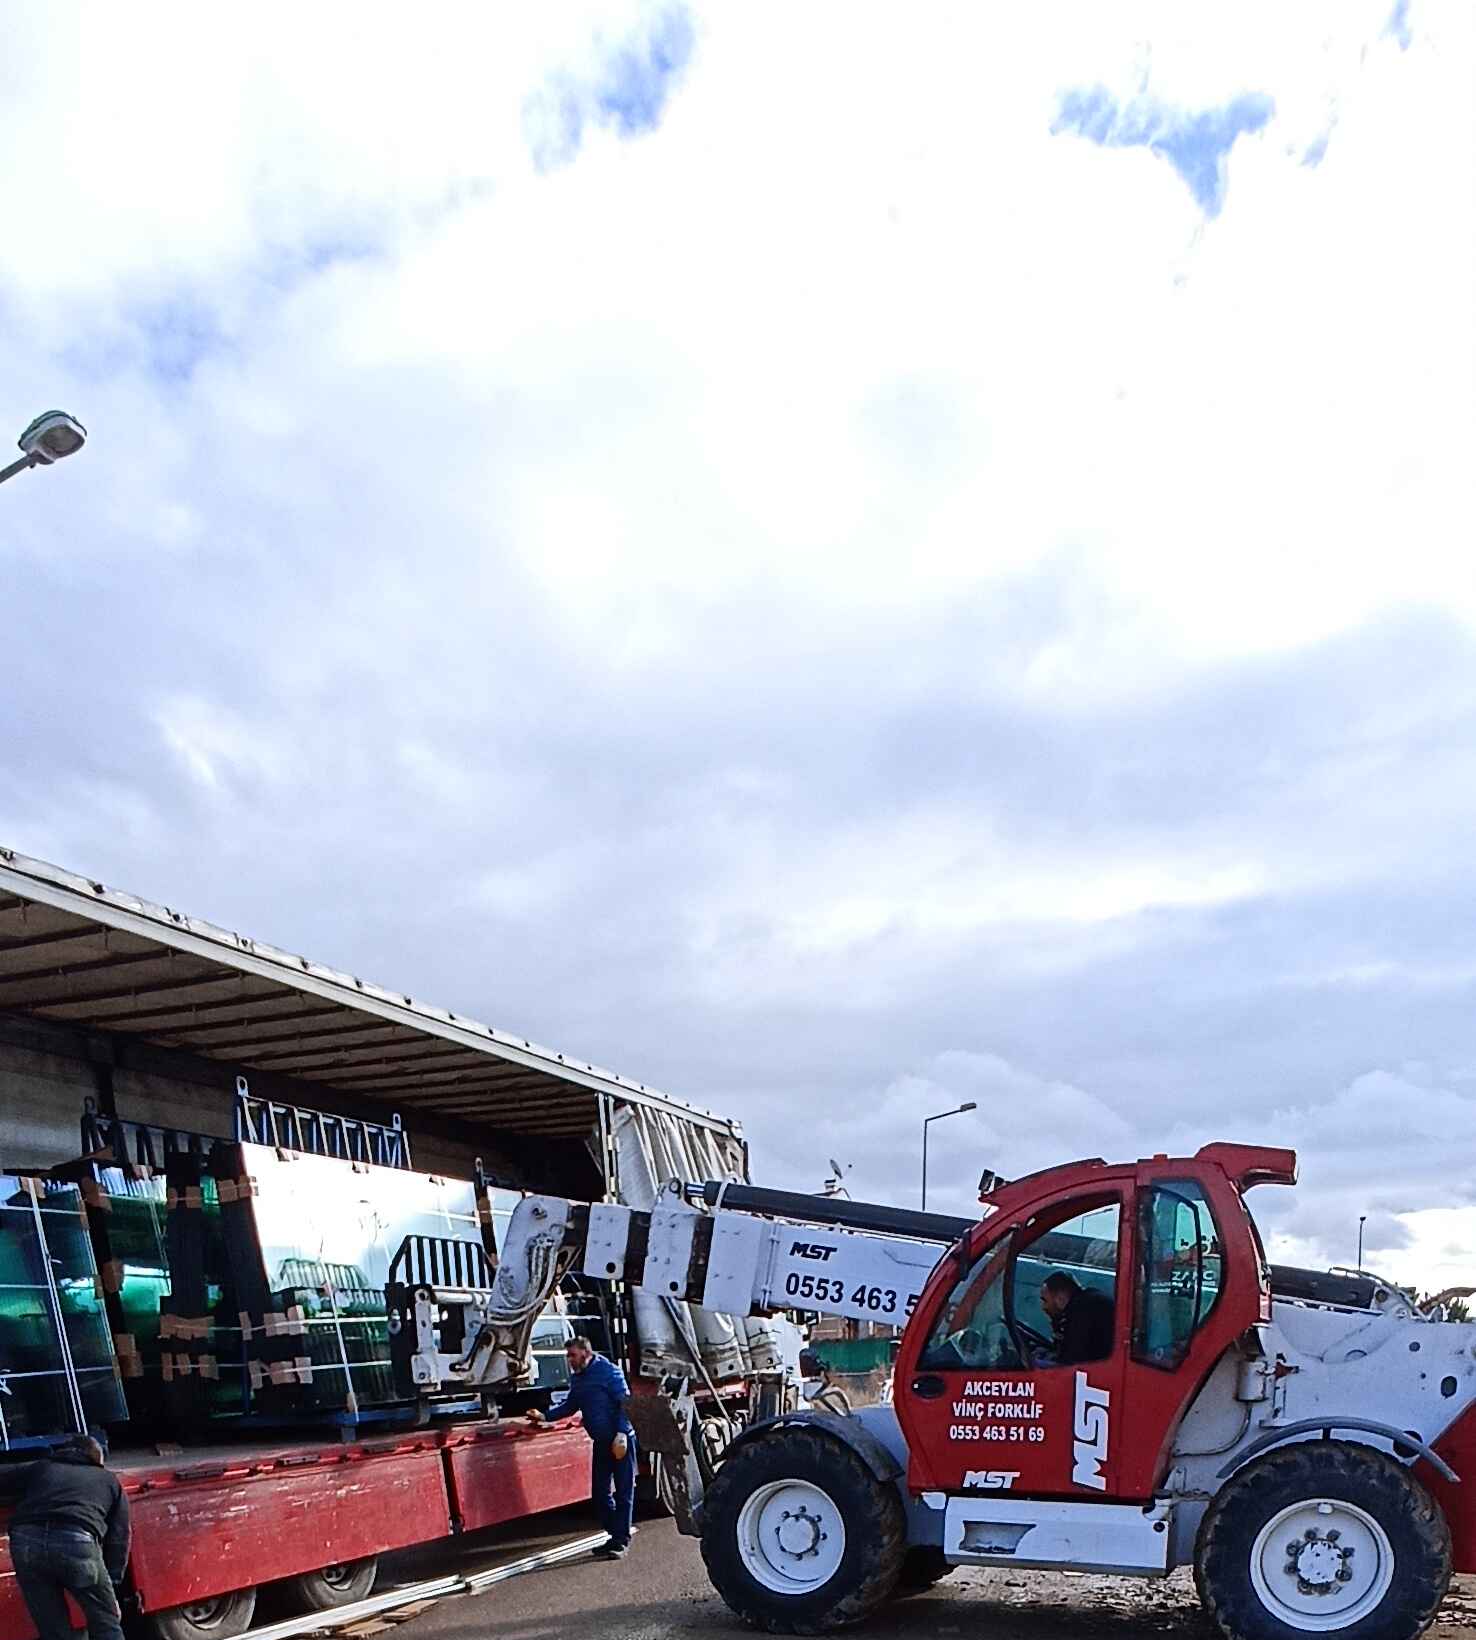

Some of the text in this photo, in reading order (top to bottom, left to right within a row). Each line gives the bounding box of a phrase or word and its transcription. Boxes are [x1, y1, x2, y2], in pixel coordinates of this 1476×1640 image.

[789, 1241, 838, 1261] MST
[785, 1272, 920, 1317] 0553 463 5
[964, 1381, 1035, 1397] AKCEYLAN
[952, 1399, 1044, 1420] VİNÇ FORKLİF
[950, 1425, 1045, 1442] 0553 463 51 69
[1072, 1370, 1110, 1491] MST
[962, 1470, 1021, 1488] MST
